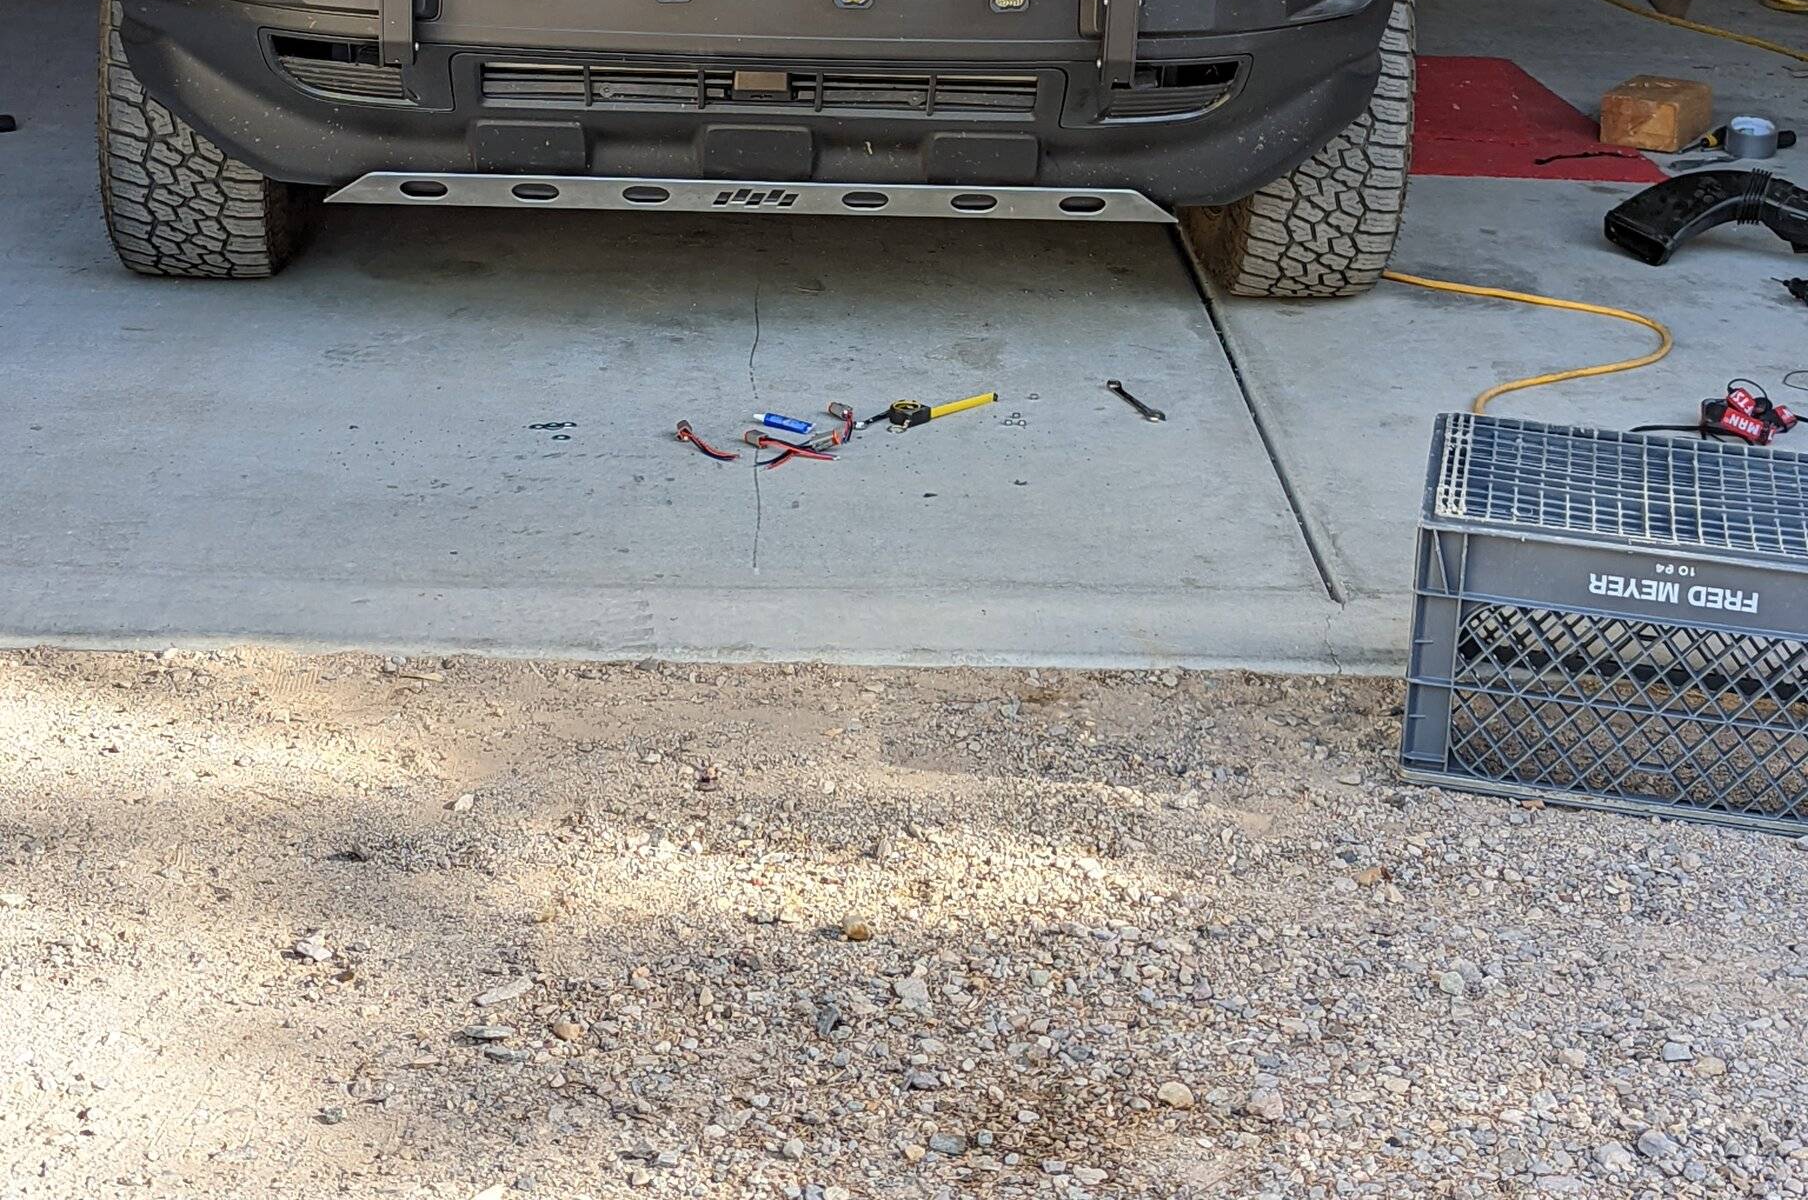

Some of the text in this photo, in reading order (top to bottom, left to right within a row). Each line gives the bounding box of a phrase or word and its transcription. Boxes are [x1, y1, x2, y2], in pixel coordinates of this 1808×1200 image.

[1678, 565, 1696, 577] 10
[1588, 573, 1759, 614] FRED MEYER
